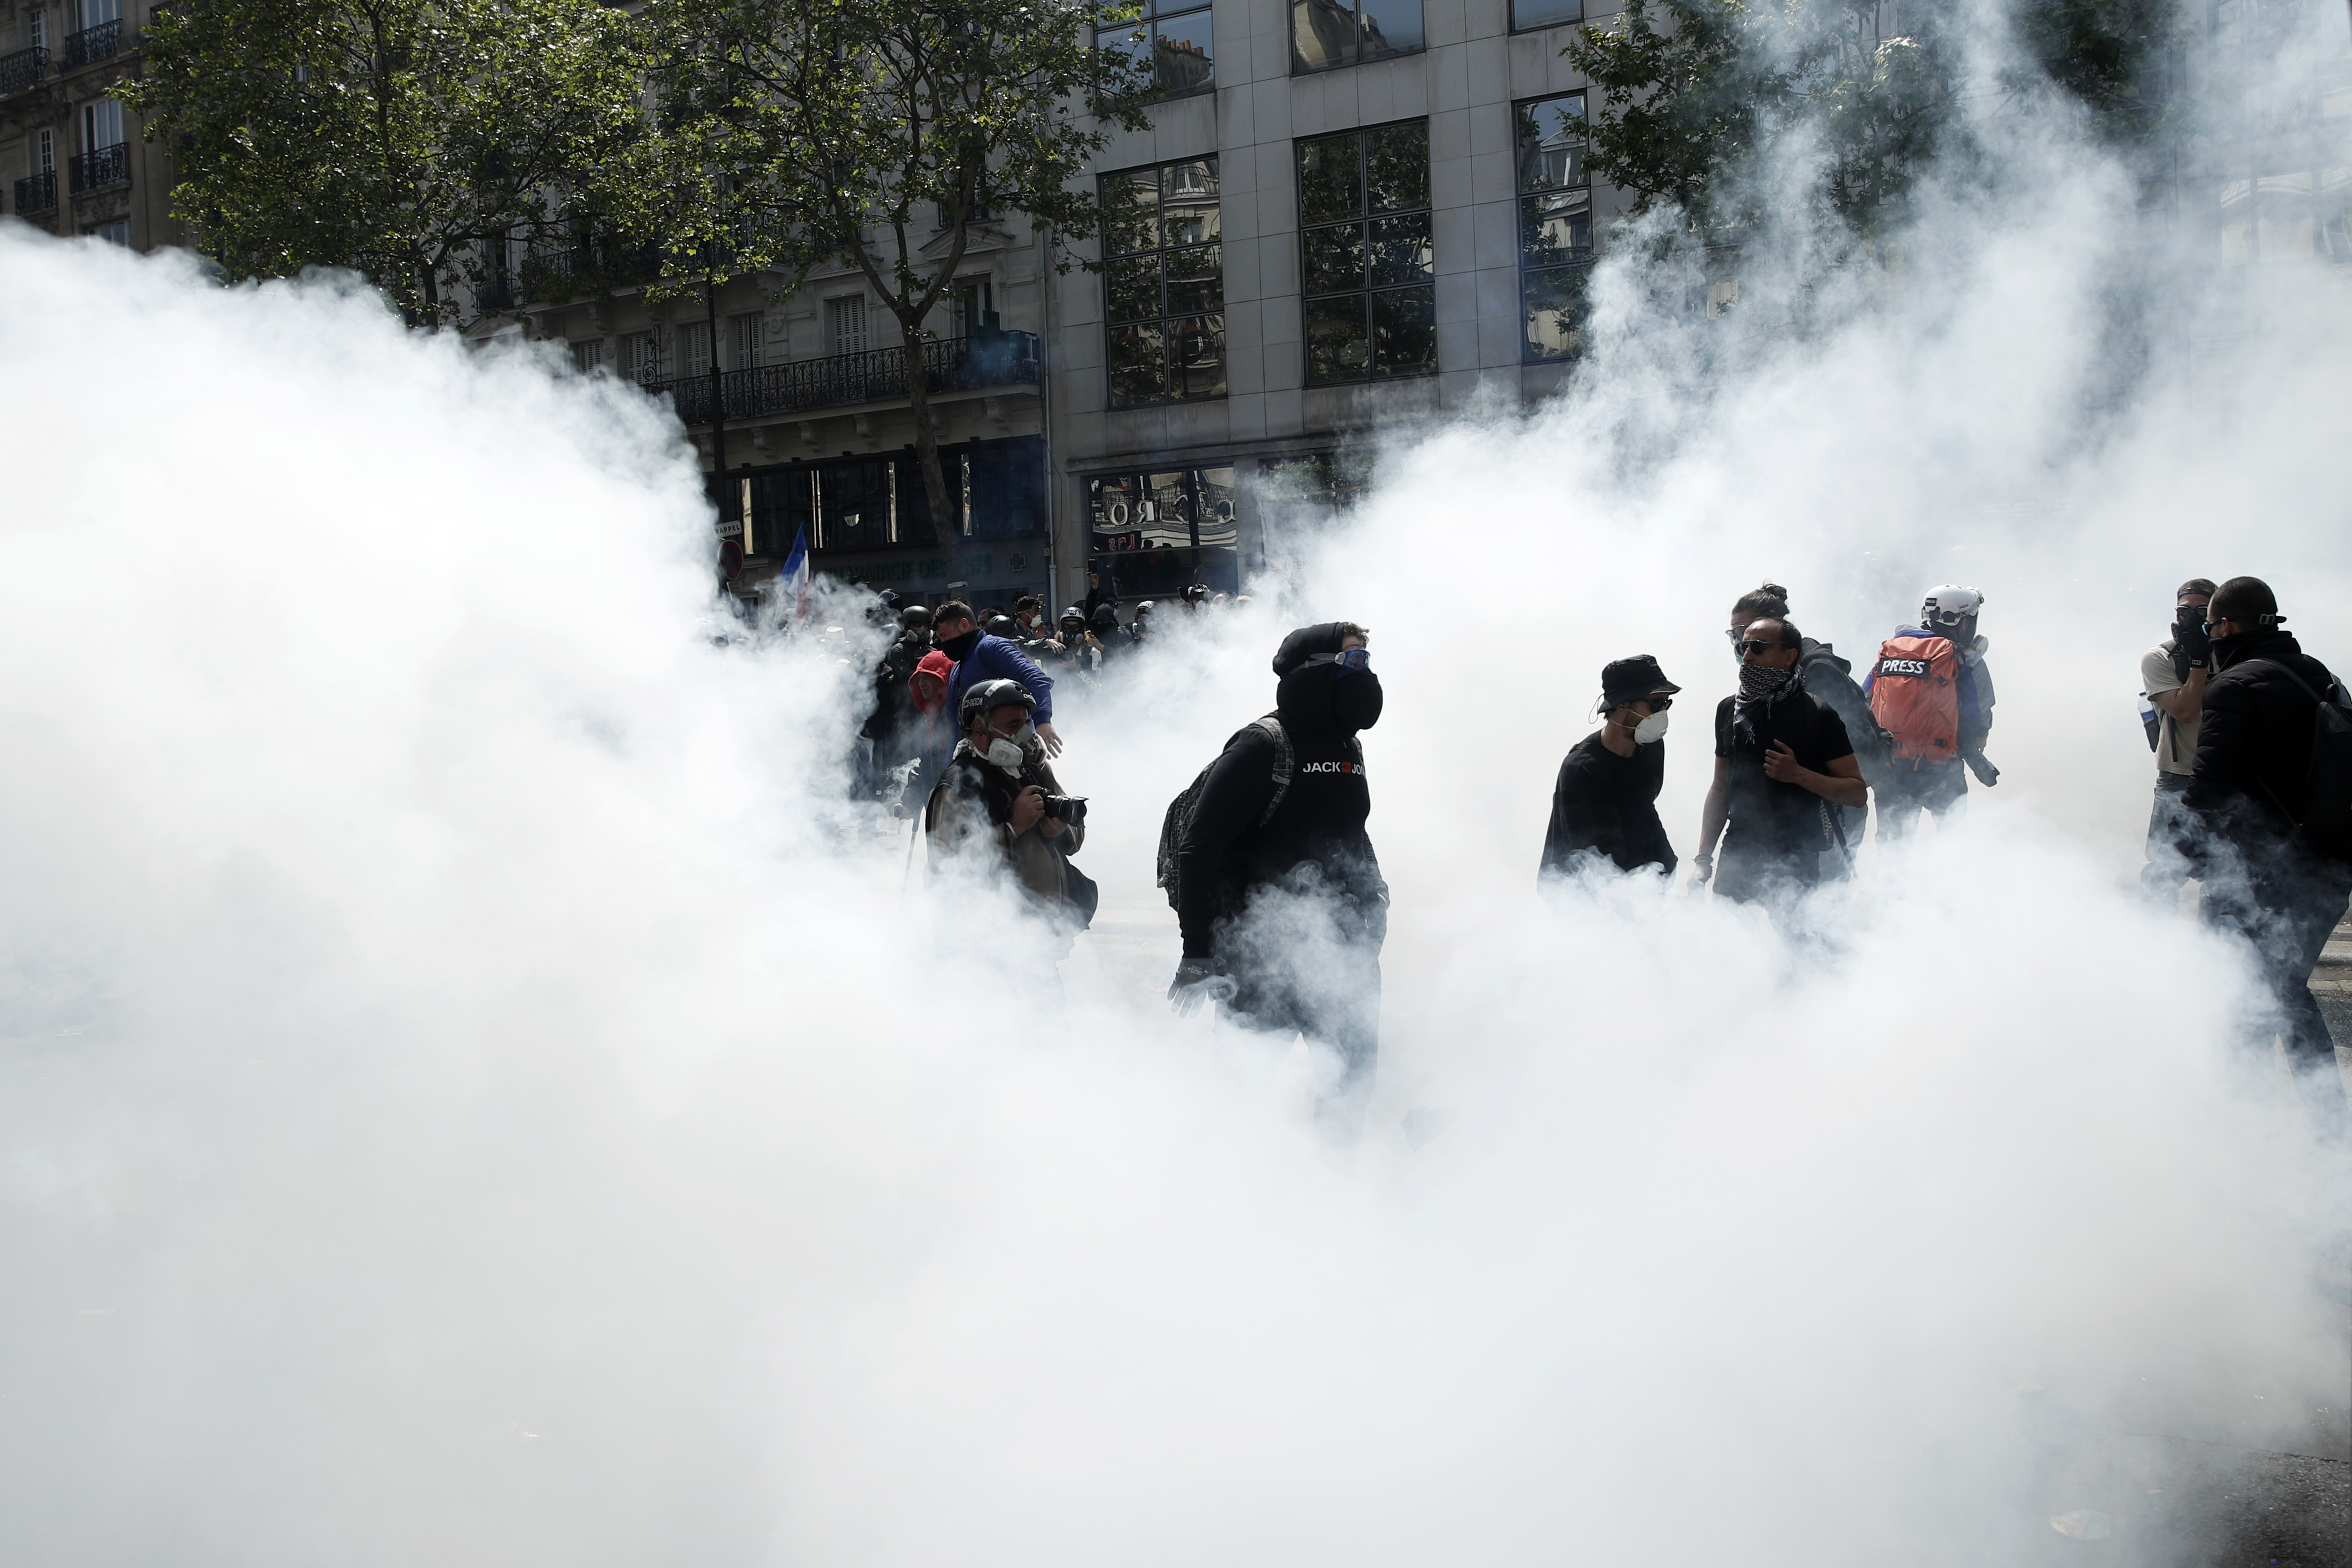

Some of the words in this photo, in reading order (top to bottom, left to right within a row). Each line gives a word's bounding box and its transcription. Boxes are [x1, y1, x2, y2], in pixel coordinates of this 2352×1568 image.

[714, 524, 741, 534] RAPPEL
[918, 558, 946, 578] DES
[962, 554, 993, 575] RTS
[1881, 660, 1925, 674] PRESS
[1078, 671, 1097, 689] SUZU
[1302, 761, 1341, 773] JACK
